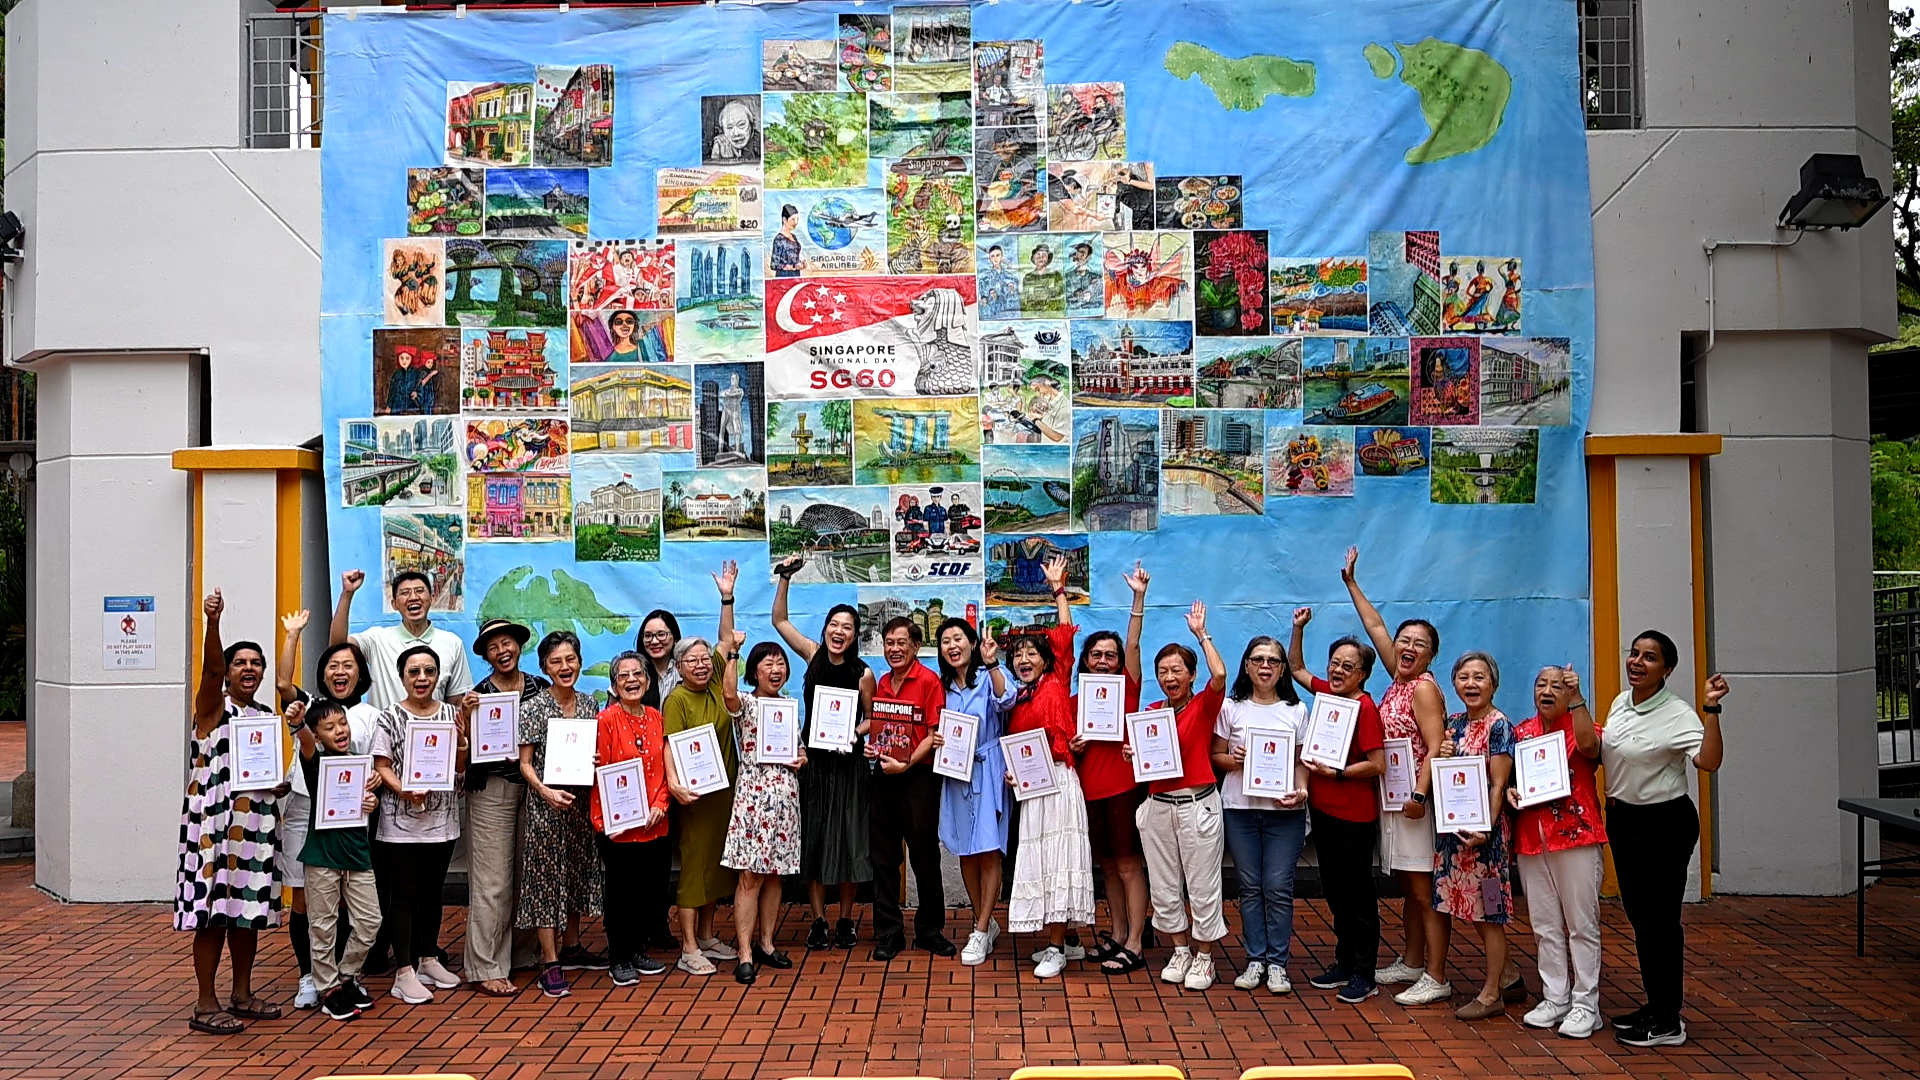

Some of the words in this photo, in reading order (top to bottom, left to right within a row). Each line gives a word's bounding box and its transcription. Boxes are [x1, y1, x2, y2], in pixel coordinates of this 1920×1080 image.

[740, 219, 758, 229] $20
[809, 345, 896, 356] SINGAPORE
[810, 357, 869, 365] NATIONAL
[809, 368, 896, 389] SG60
[1104, 420, 1113, 488] CAPITOL
[927, 562, 972, 576] SCDF
[873, 702, 913, 716] SINGAPORE
